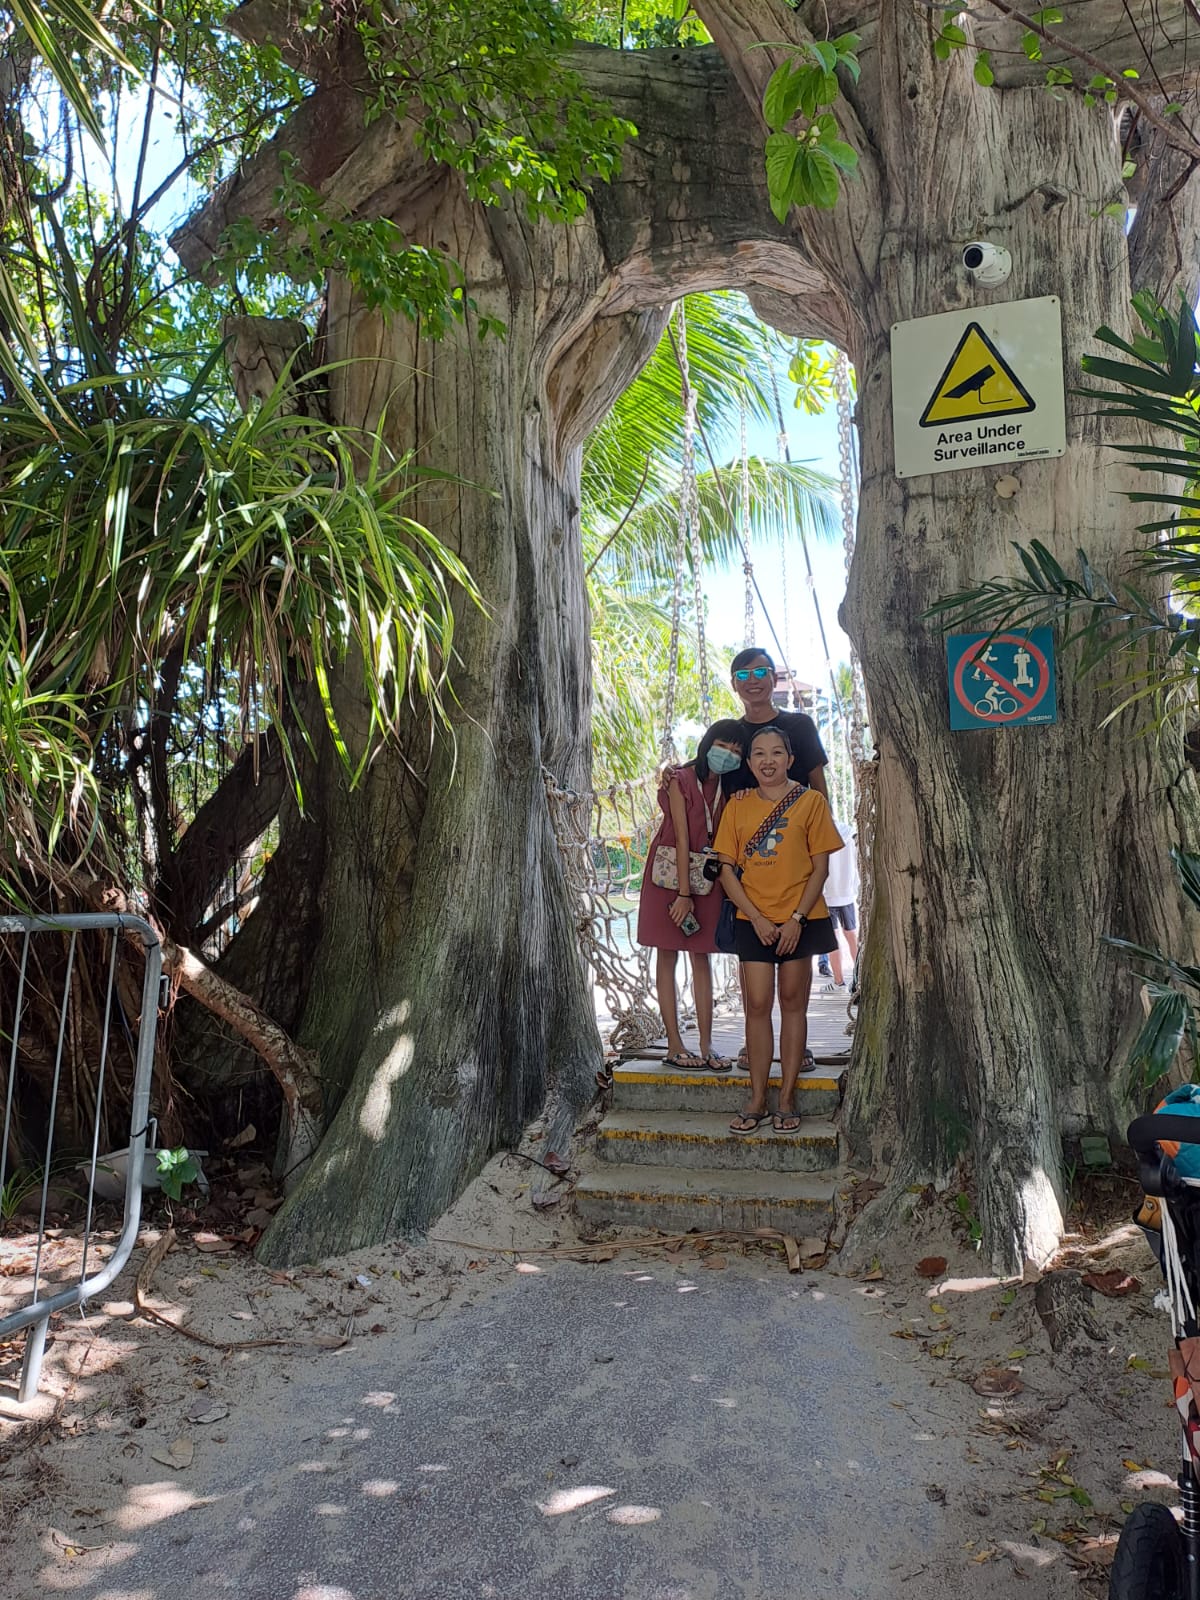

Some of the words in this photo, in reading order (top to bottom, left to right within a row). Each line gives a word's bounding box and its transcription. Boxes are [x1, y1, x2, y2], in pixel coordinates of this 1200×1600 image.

[937, 432, 972, 445] Area
[977, 424, 1022, 439] Under
[934, 440, 1025, 461] Surveillance
